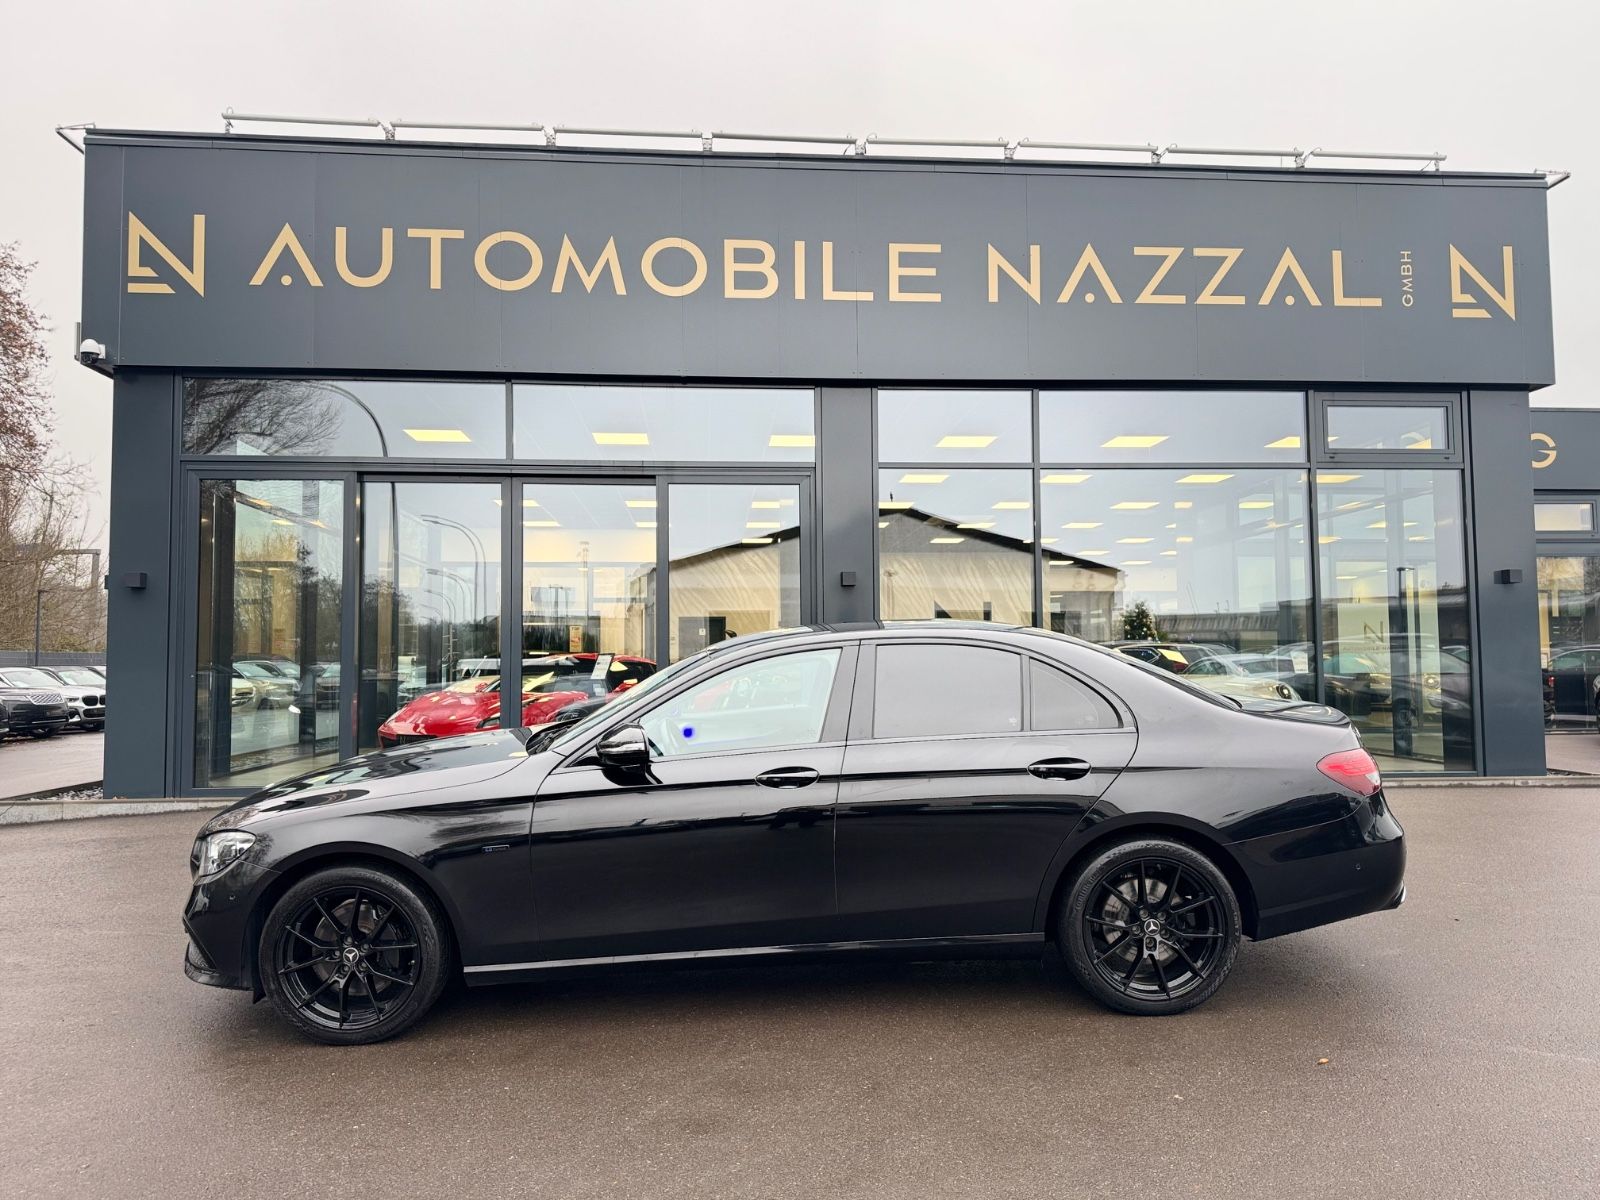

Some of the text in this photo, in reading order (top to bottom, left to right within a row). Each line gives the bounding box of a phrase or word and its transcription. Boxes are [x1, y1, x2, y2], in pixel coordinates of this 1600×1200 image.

[249, 222, 1383, 308] AUTOMOBILE NAZZAL
[1400, 250, 1414, 307] GMBH
